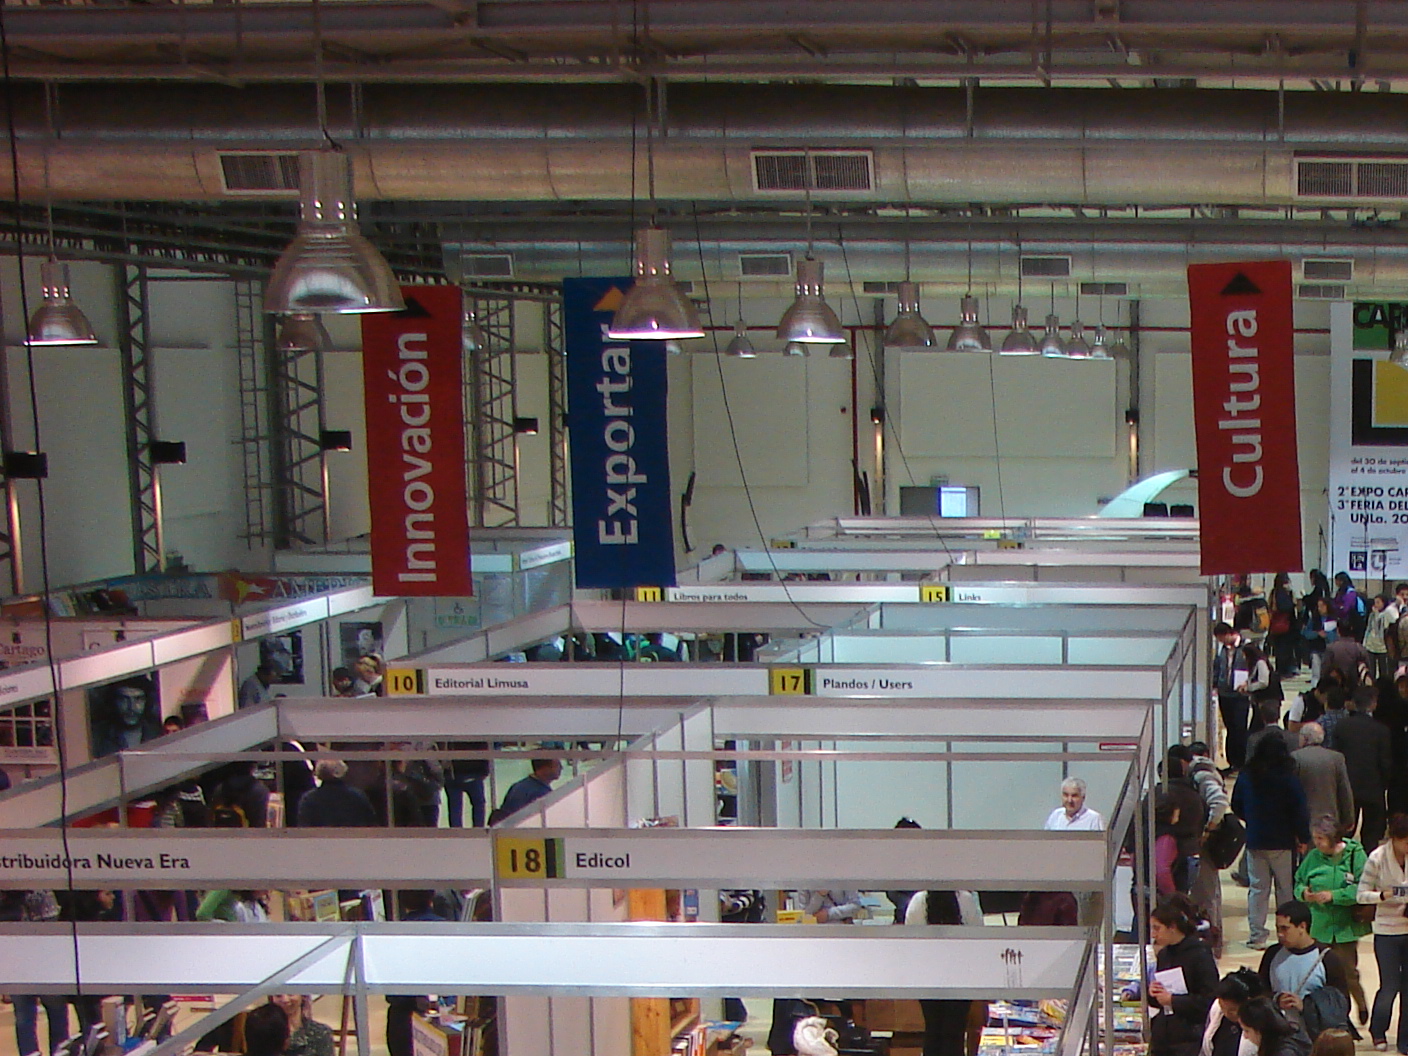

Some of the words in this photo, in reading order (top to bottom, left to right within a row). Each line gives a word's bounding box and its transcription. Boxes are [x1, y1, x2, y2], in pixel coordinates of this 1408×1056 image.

[1219, 309, 1264, 498] Cultura
[388, 331, 437, 583] Innovación
[1351, 487, 1384, 497] EXPO
[1351, 501, 1384, 511] FERIA
[674, 592, 700, 601] Libros
[724, 592, 748, 601] todos
[928, 591, 943, 602] 15
[0, 645, 45, 657] artago
[393, 675, 413, 691] 10
[435, 678, 484, 689] Editorial
[487, 679, 529, 689] Limusa
[781, 675, 800, 690] 17
[823, 679, 868, 690] Plandos
[879, 679, 913, 690] Users
[0, 853, 92, 869] tribuidora
[96, 854, 153, 870] Nueva
[159, 854, 190, 870] Era
[509, 848, 541, 873] 18
[575, 852, 631, 869] Edicol
